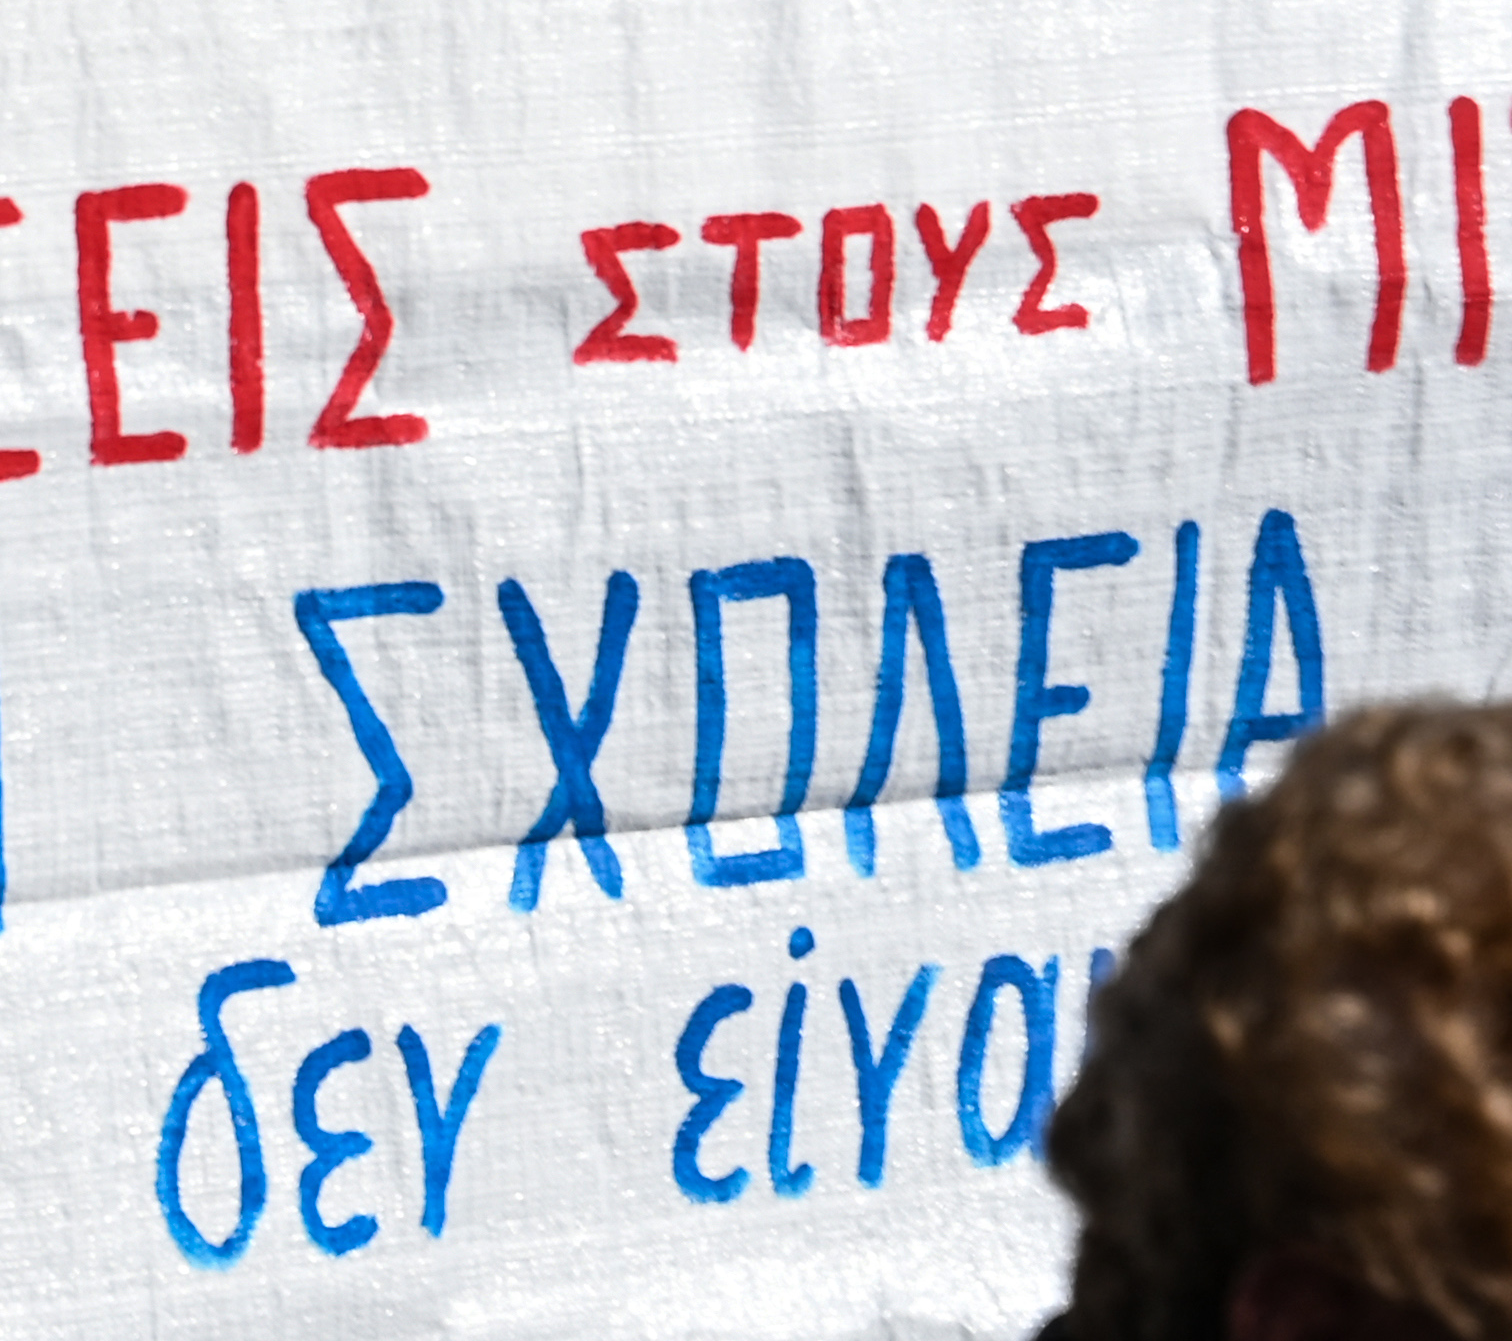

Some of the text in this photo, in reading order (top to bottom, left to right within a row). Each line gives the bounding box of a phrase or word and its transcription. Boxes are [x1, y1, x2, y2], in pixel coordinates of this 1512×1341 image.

[573, 191, 1100, 365] ΣΤΟΥΣ
[1225, 95, 1512, 386] ΜΙ
[292, 507, 1328, 929] ΣΧΟΛΕΙΑ
[153, 957, 503, 1269] δεν
[671, 925, 1120, 1205] είνα
